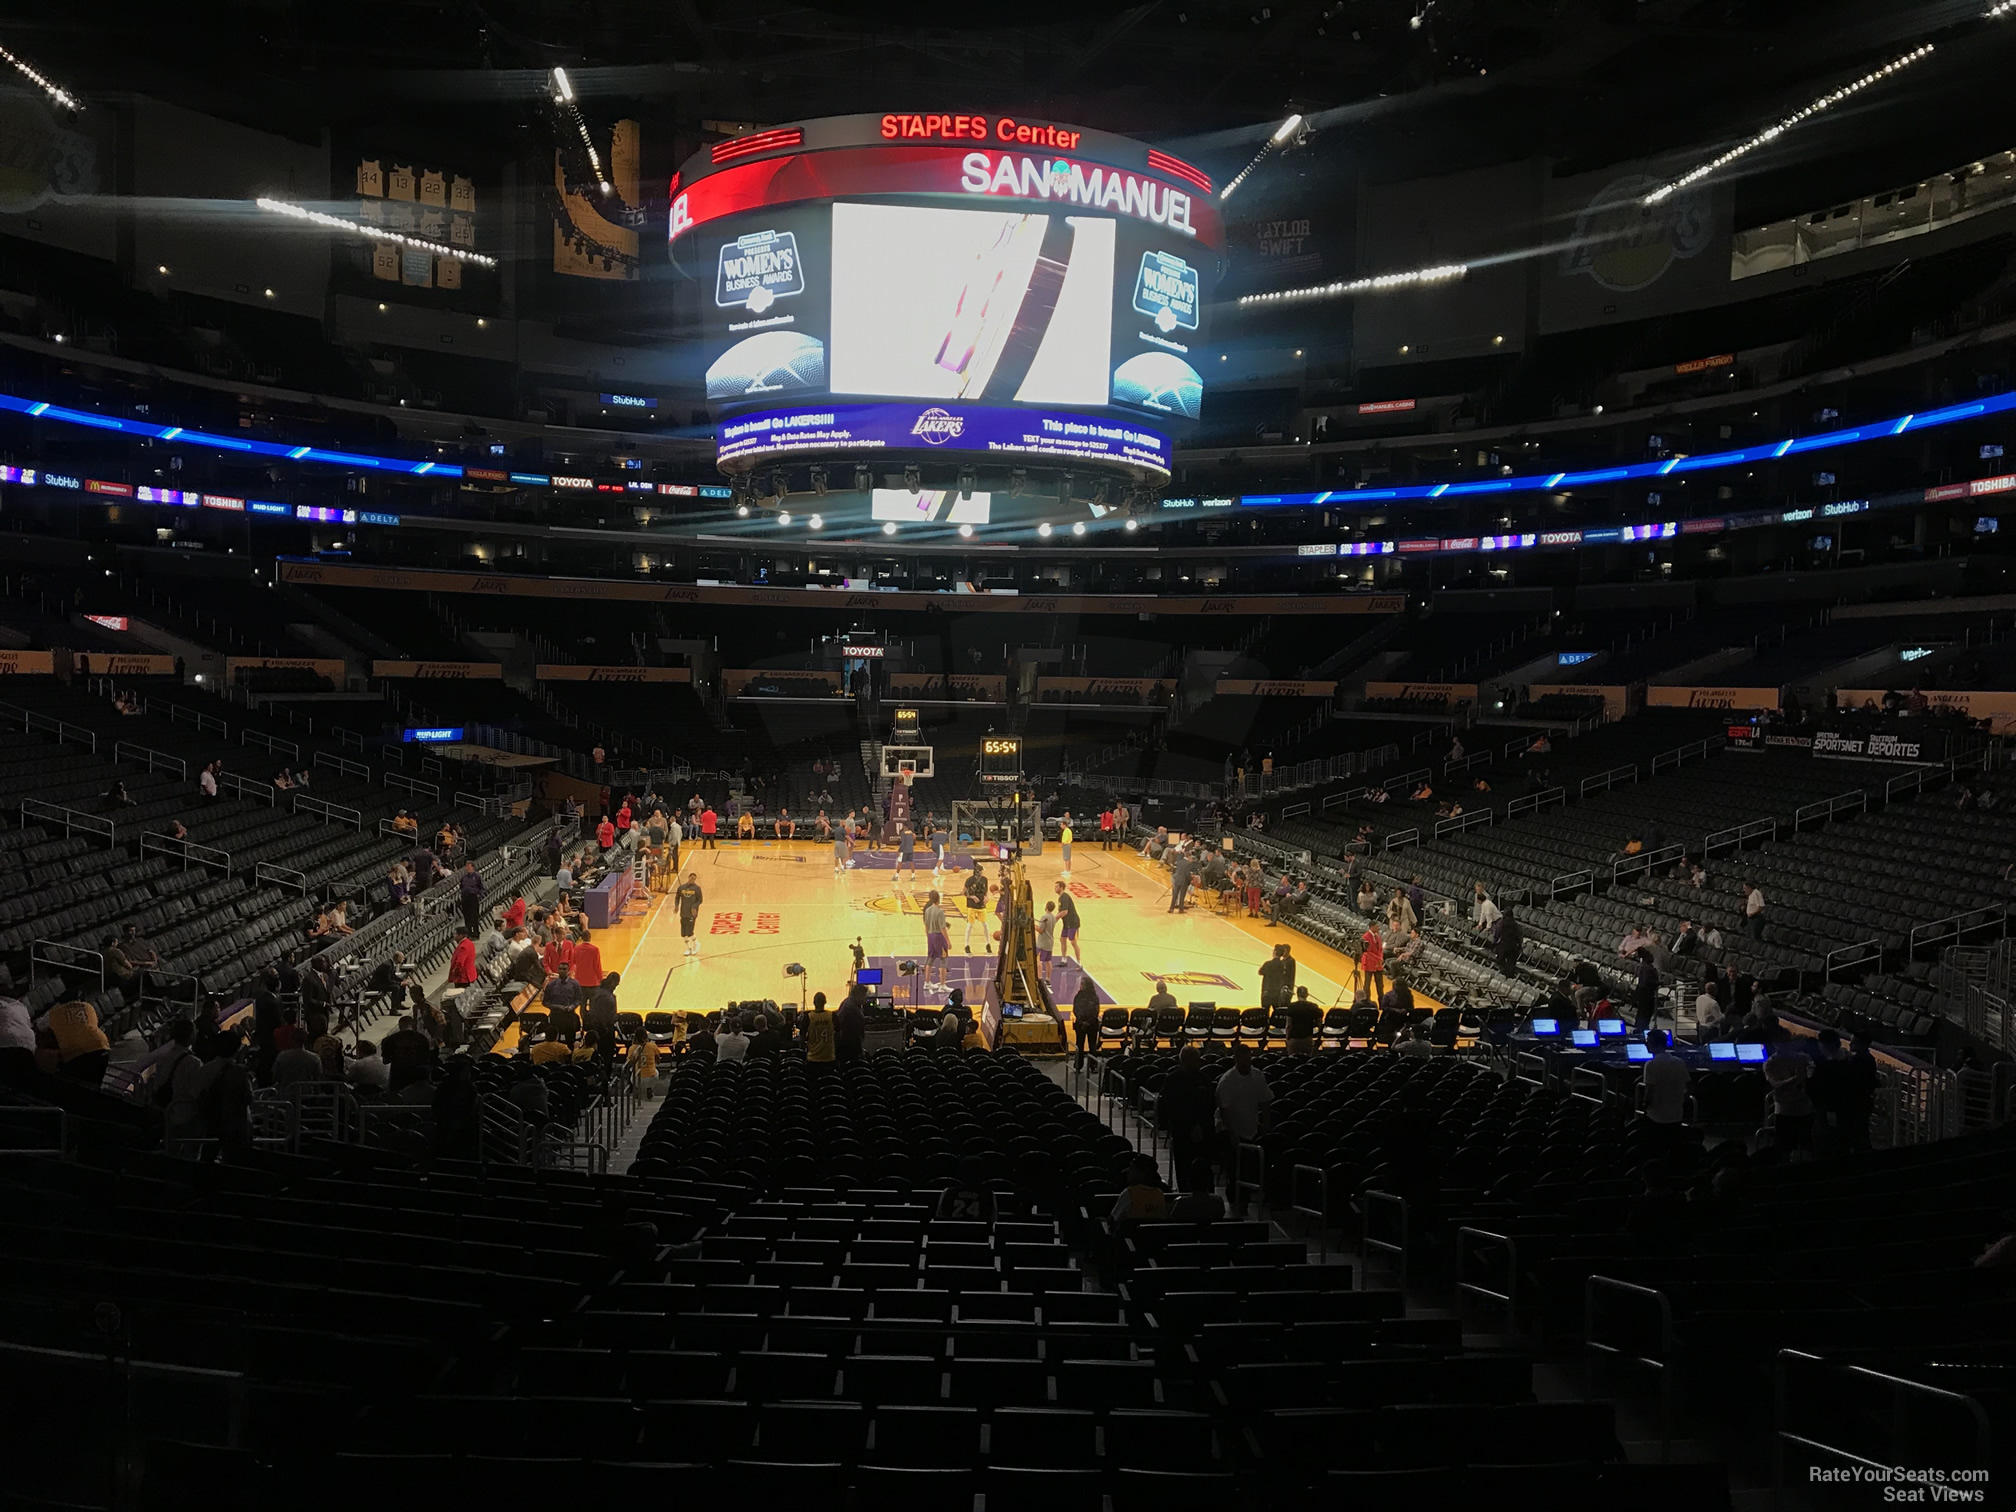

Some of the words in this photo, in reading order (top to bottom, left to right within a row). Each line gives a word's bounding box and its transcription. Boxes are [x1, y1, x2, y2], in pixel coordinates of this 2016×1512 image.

[881, 114, 986, 138] STAPLES
[997, 119, 1082, 149] Center
[425, 182, 440, 194] 22
[961, 152, 1050, 195] SAN
[1069, 166, 1198, 236] MANUEL
[1260, 238, 1304, 256] SWIFT
[724, 248, 793, 280] WOMEN'S
[726, 276, 760, 292] BUSINESS
[763, 270, 793, 285] AWARDS
[1144, 267, 1195, 304] WOMEN'S
[612, 395, 645, 407] StubHub
[772, 417, 783, 429] Go
[910, 415, 964, 437] LAKERS
[1043, 419, 1063, 431] This
[1065, 422, 1088, 435] place
[1089, 424, 1097, 435] is
[848, 439, 885, 447] participate
[1023, 434, 1040, 443] TEXT
[988, 441, 1001, 450] The
[1002, 443, 1025, 452] Lakers
[45, 473, 79, 489] StubHub
[552, 476, 593, 488] TOYOTA
[1971, 476, 2016, 493] TOSHIBA
[204, 494, 244, 509] TOSHIBA
[252, 503, 266, 511] BUD
[266, 504, 285, 513] LIGHT
[1163, 498, 1194, 507] StubHub
[1202, 498, 1231, 507] verizon
[1824, 501, 1859, 515] StubHub
[370, 514, 399, 524] DELTA
[1783, 509, 1812, 521] verizon
[1541, 532, 1581, 543] TOYOTA
[1300, 544, 1335, 554] STAPLES
[286, 565, 322, 582] LAKERS
[472, 577, 509, 592] LAKERS
[664, 587, 700, 601] LAKERS
[1200, 599, 1236, 612] LAKERS
[1367, 597, 1400, 611] LAKERS
[843, 646, 884, 657] TOYOTA
[898, 711, 916, 719] 65:54
[431, 730, 452, 739] LIGHT
[1752, 727, 1760, 738] LA
[985, 741, 1017, 753] 65:54
[1813, 739, 1864, 753] SPORTSNET
[1867, 742, 1920, 758] DEPORTES
[709, 912, 743, 934] STAPLES
[748, 912, 780, 934] Center
[66, 1009, 88, 1024] 14
[952, 1199, 980, 1218] 24
